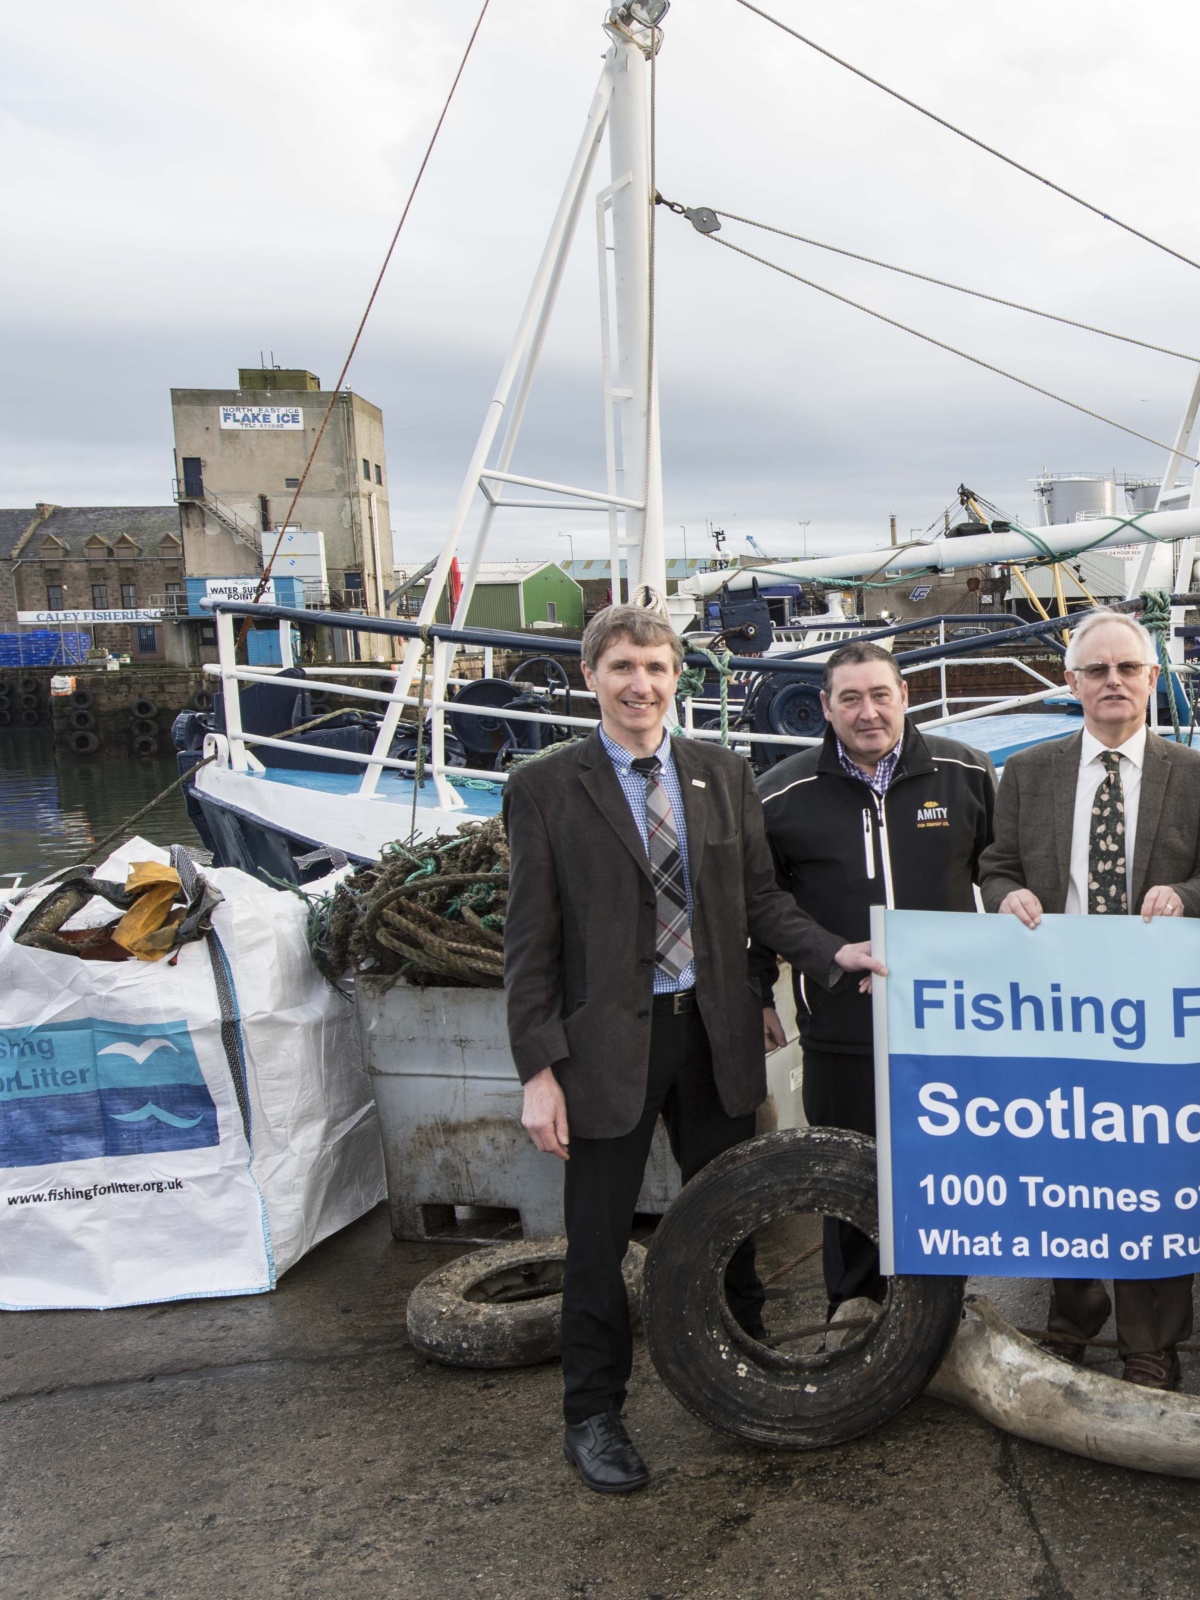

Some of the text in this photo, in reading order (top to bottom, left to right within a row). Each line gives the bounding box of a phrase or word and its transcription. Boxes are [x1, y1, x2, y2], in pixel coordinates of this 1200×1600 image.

[223, 413, 300, 423] FLAKE ICE
[211, 586, 238, 594] WATER
[36, 612, 80, 622] CALEY
[917, 807, 948, 821] AMITY
[912, 978, 1147, 1050] Fishing
[15, 1067, 90, 1091] Litter
[7, 1178, 184, 1206] www.fishingforlitter.org.uk
[919, 1174, 1007, 1206] 1000
[1019, 1176, 1161, 1213] Tonnes
[919, 1228, 1003, 1256] What
[1012, 1236, 1031, 1257] a
[1041, 1231, 1110, 1260] load
[1119, 1235, 1153, 1261] of
